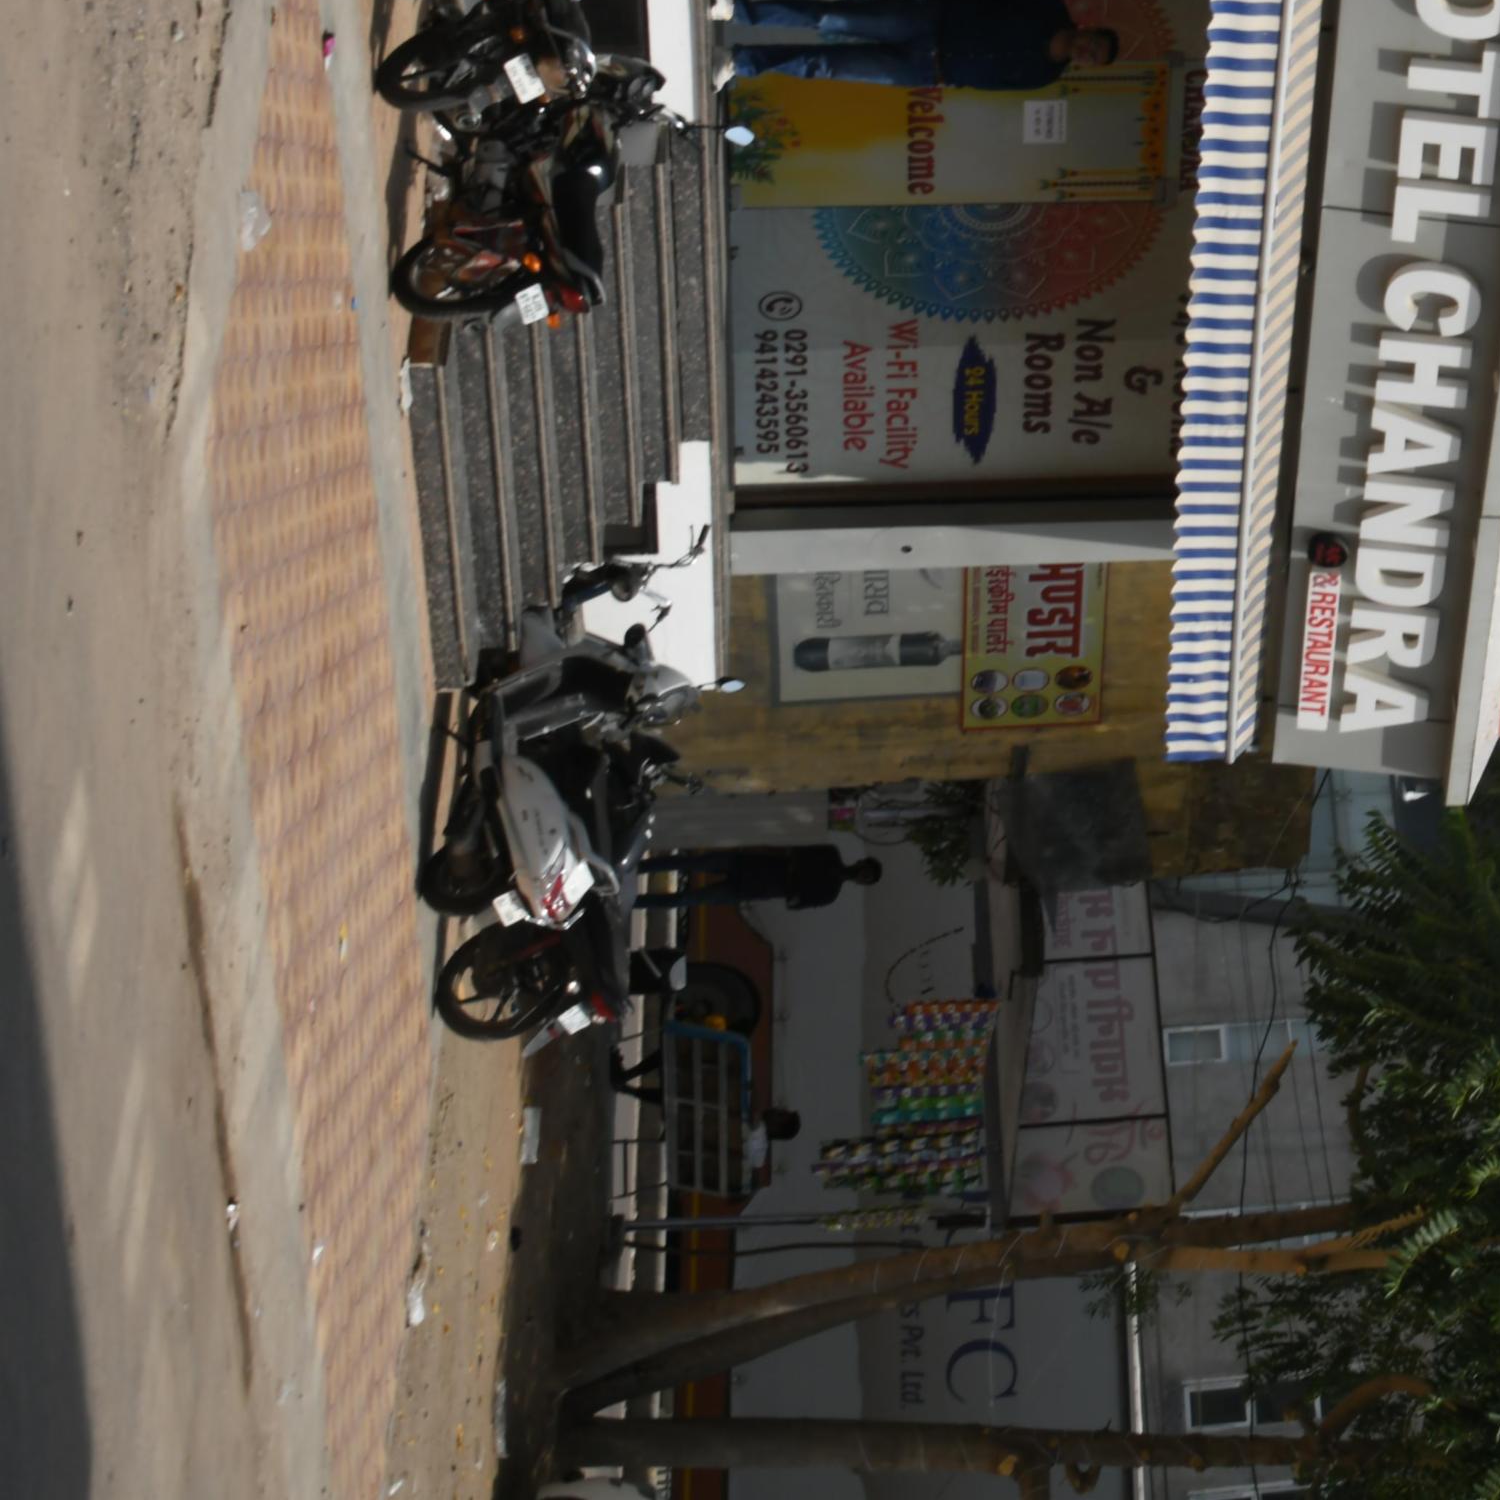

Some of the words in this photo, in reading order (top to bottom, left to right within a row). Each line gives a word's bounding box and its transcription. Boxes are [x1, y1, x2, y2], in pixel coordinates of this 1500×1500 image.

[886, 318, 919, 380] Wi-Fi
[1023, 333, 1066, 434] Rooms
[1073, 318, 1116, 384] Non
[1124, 366, 1164, 395] &
[754, 329, 780, 455] 9414243595
[784, 329, 810, 474] 0291-3560613
[842, 340, 875, 452] Available
[878, 387, 919, 470] Facility
[963, 390, 984, 437] Hours
[1067, 392, 1113, 446] A/c
[1339, 262, 1483, 734] CHANDRA
[985, 566, 1016, 615] ईस्क्रीम
[1301, 591, 1337, 716] RESTAURANT
